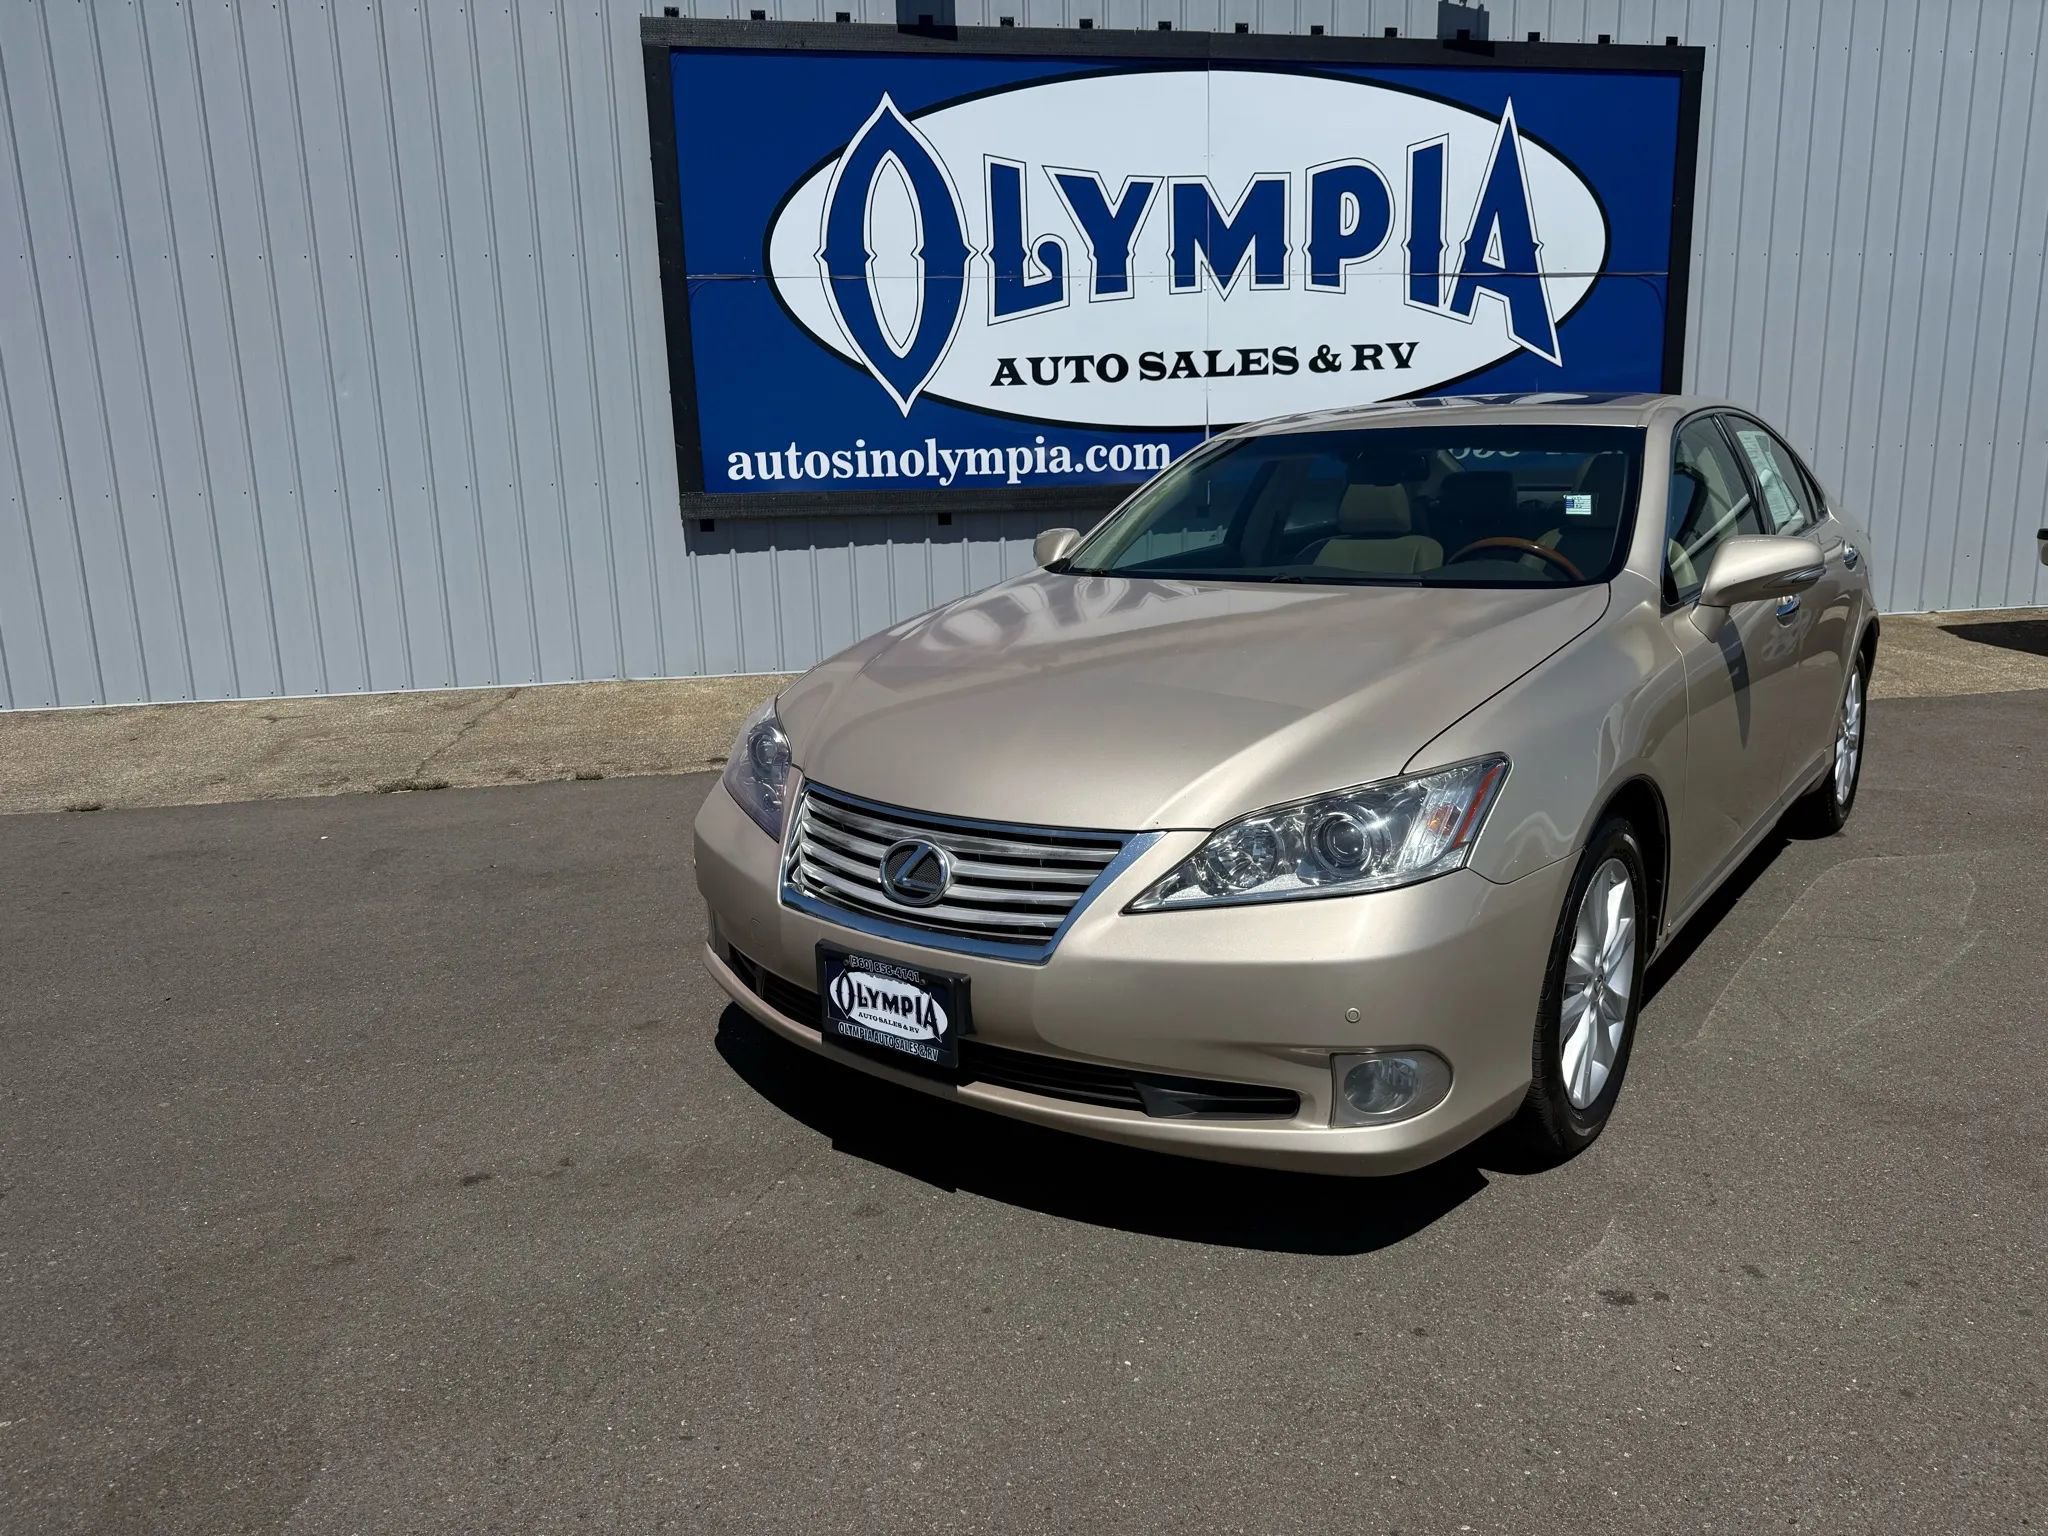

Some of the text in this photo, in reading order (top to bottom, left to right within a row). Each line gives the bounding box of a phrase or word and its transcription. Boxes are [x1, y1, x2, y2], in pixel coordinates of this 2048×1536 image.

[813, 90, 1563, 417] OLYMPIA
[990, 341, 1420, 387] AUTO SALES & RV
[726, 435, 1172, 486] autosinolympia.com
[849, 955, 874, 973] (360)
[836, 968, 943, 1044] OLYMPIA
[858, 1011, 878, 1022] AUTO
[878, 1016, 903, 1029] SALES
[909, 1026, 920, 1034] RV
[838, 1021, 939, 1062] OLYMPIA AUTO SALES & RV
